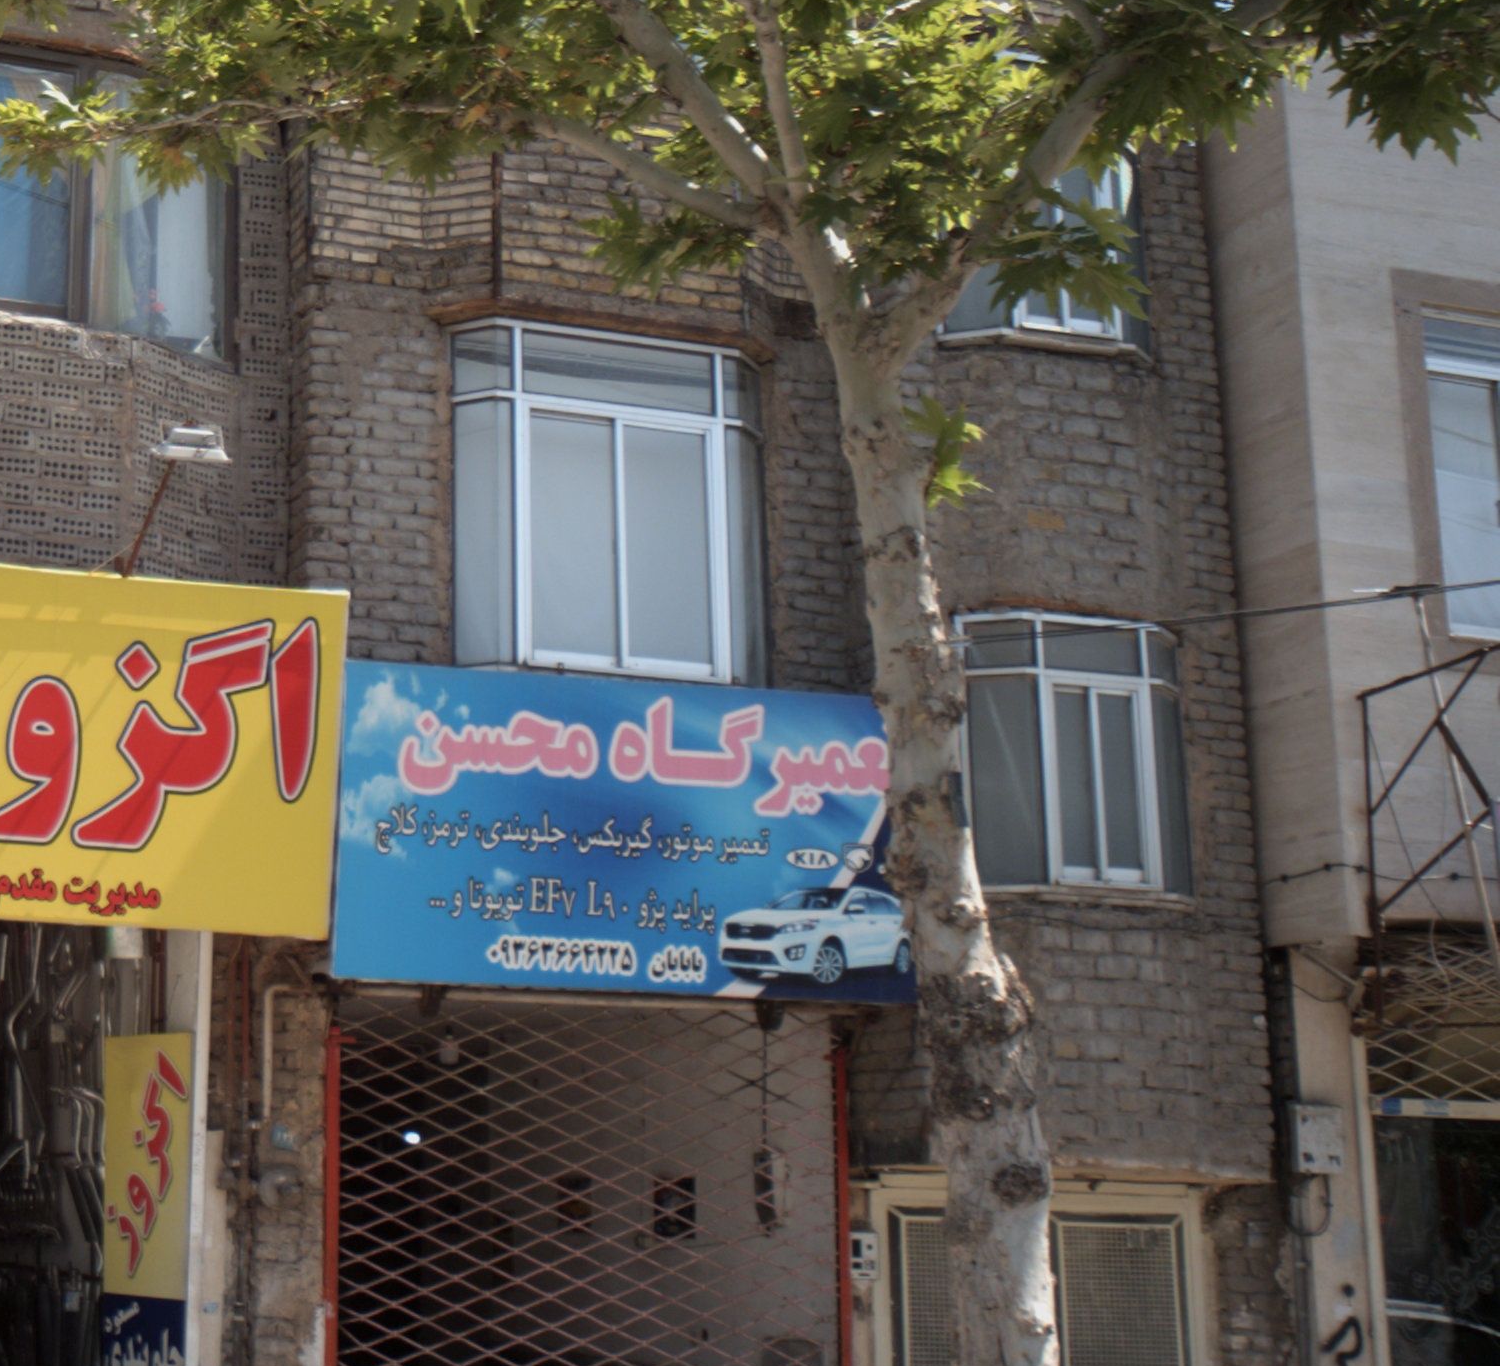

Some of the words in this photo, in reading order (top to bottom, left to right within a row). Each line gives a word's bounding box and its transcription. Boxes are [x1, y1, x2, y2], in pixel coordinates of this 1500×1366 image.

[398, 710, 600, 796] محسن
[608, 696, 766, 788] گاه
[754, 735, 890, 815] عمیر
[375, 803, 419, 854] کلاچ
[719, 828, 771, 864] تعمیر
[62, 875, 162, 917] مدیریت
[448, 889, 464, 919] و
[465, 877, 526, 922] تویوتا
[637, 887, 668, 933] پژو
[671, 888, 717, 934] پراید
[650, 945, 706, 981] بابایان
[106, 1049, 188, 1280] اگزوز
[104, 1301, 141, 1335] مسعود
